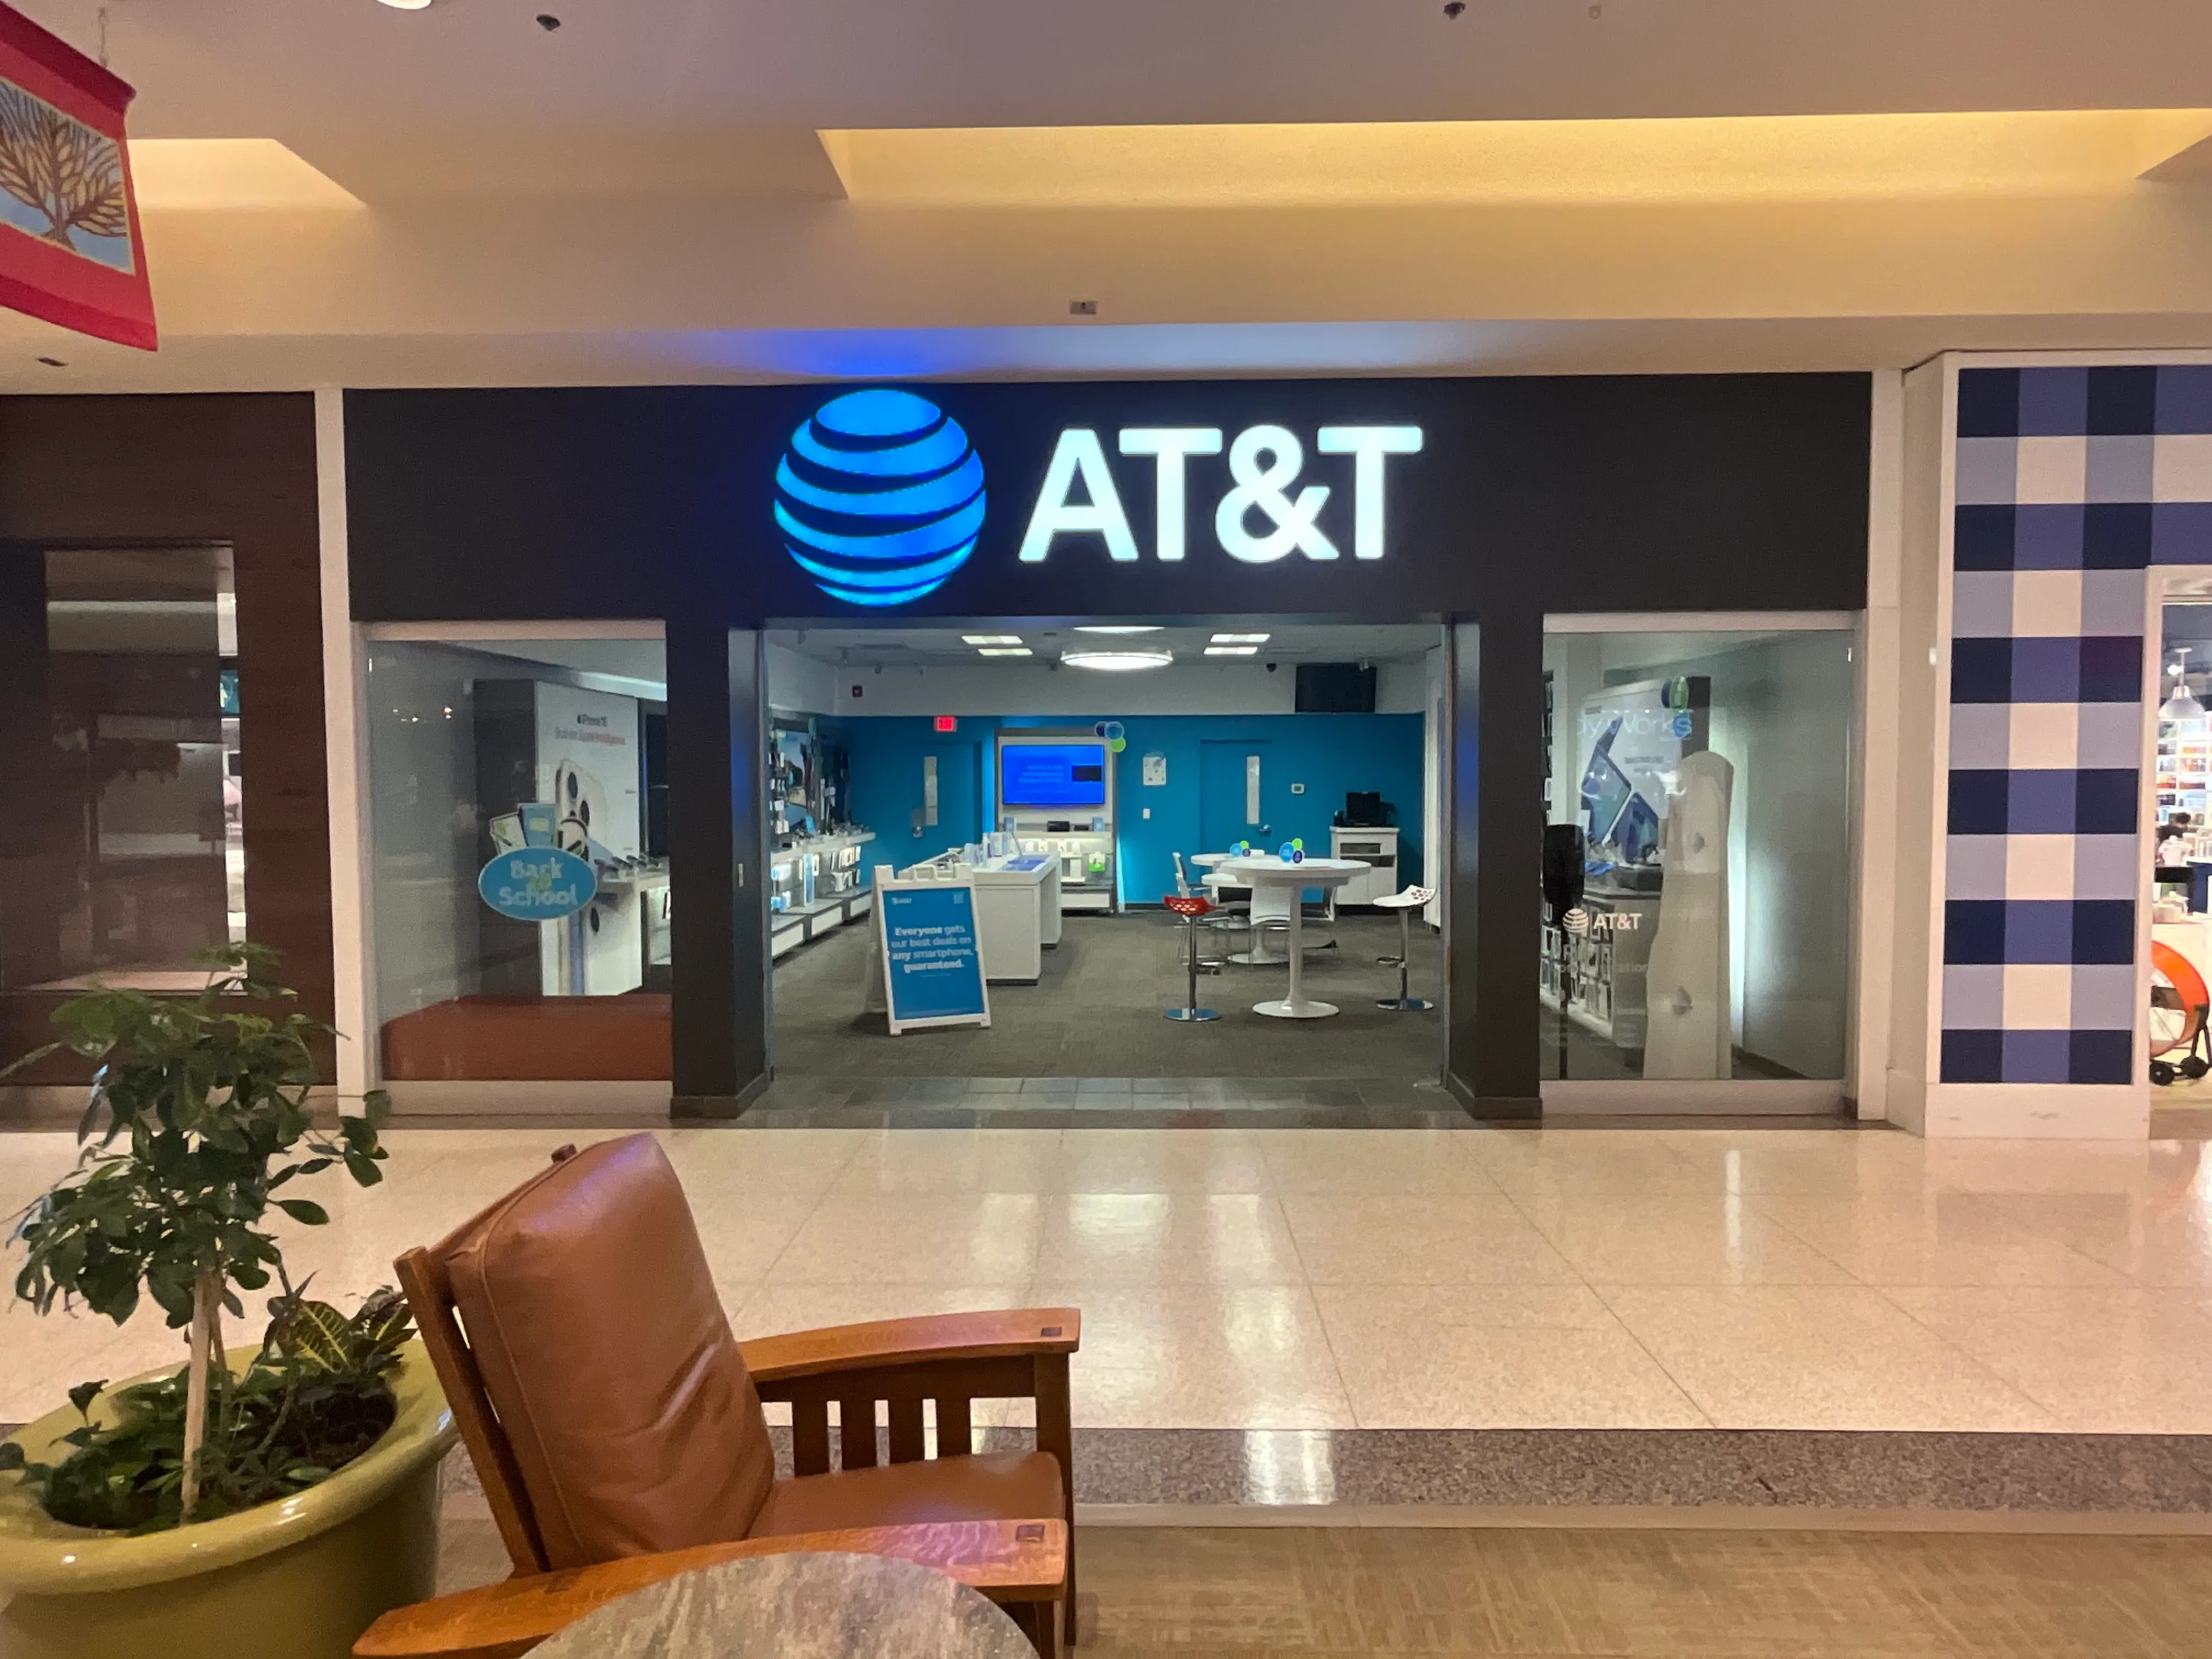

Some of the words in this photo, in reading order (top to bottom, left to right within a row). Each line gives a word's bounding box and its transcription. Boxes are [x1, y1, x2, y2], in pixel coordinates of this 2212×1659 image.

[1019, 424, 1424, 563] AT&T
[510, 857, 565, 879] Back
[499, 884, 578, 906] School
[1593, 913, 1642, 930] AT&T
[895, 926, 942, 936] Everyone
[944, 925, 966, 935] gets
[910, 938, 930, 947] best
[892, 952, 911, 961] any
